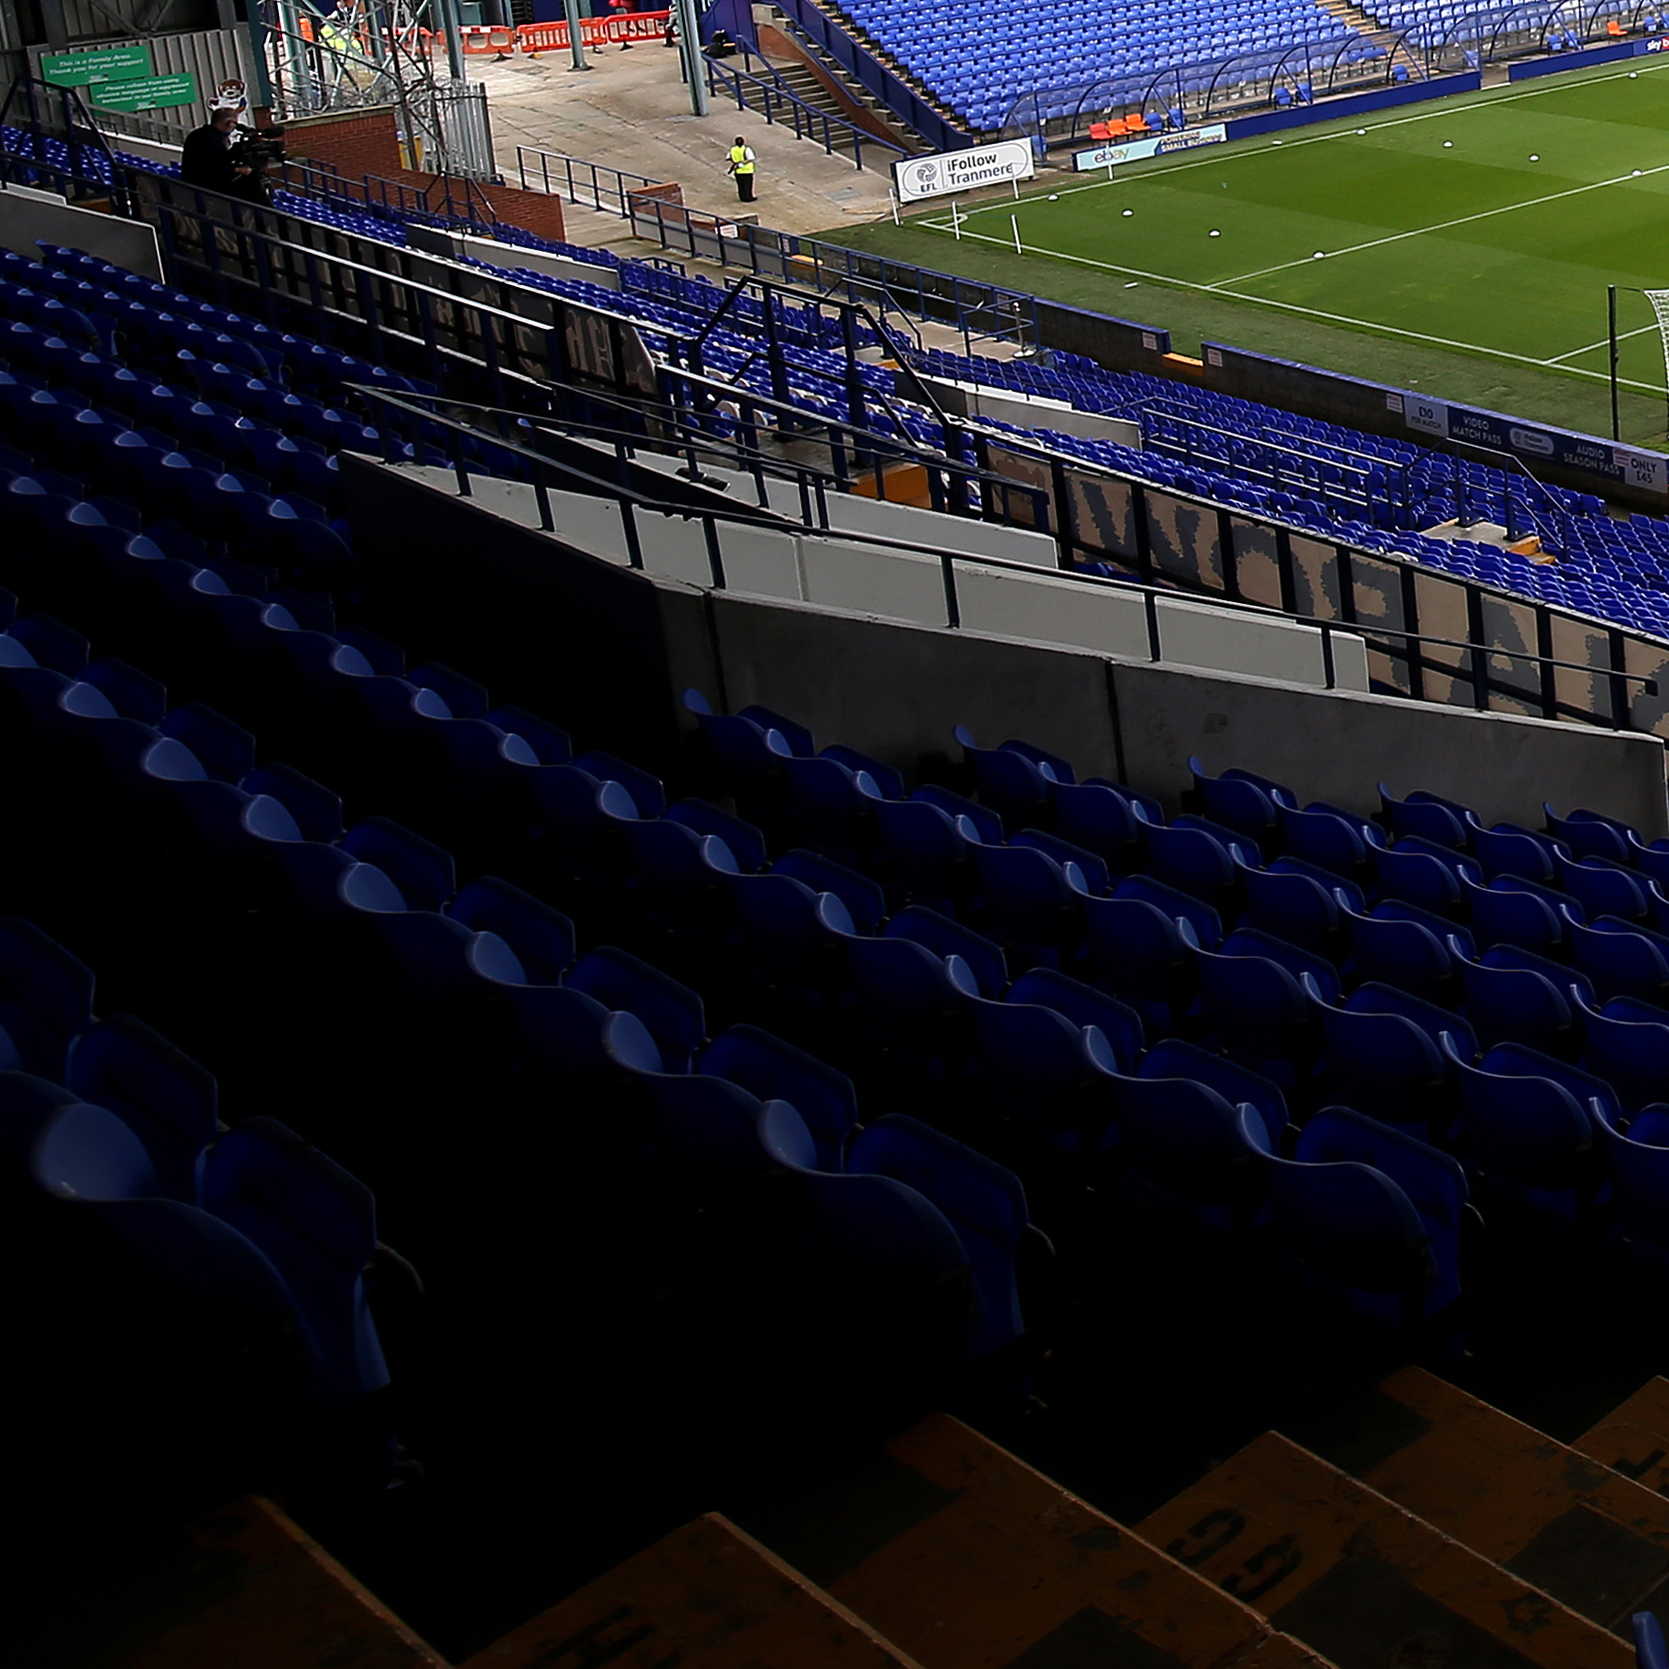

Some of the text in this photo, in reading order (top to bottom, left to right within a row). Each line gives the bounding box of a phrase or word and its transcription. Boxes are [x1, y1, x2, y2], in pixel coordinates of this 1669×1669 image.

[1646, 40, 1662, 51] sky
[88, 56, 112, 65] Family
[947, 154, 997, 172] iFollow
[1094, 147, 1130, 164] ebay
[948, 163, 1014, 185] Tranmere
[920, 183, 937, 193] EFL
[1418, 405, 1434, 420] £10
[1462, 415, 1490, 431] VIDEO
[1452, 425, 1502, 445] MATCH PASS
[1576, 444, 1605, 460] AUDIO
[1563, 452, 1599, 470] SEASON
[1599, 462, 1620, 476] PASS
[1630, 457, 1657, 473] ONLY
[1636, 471, 1653, 484] £45
